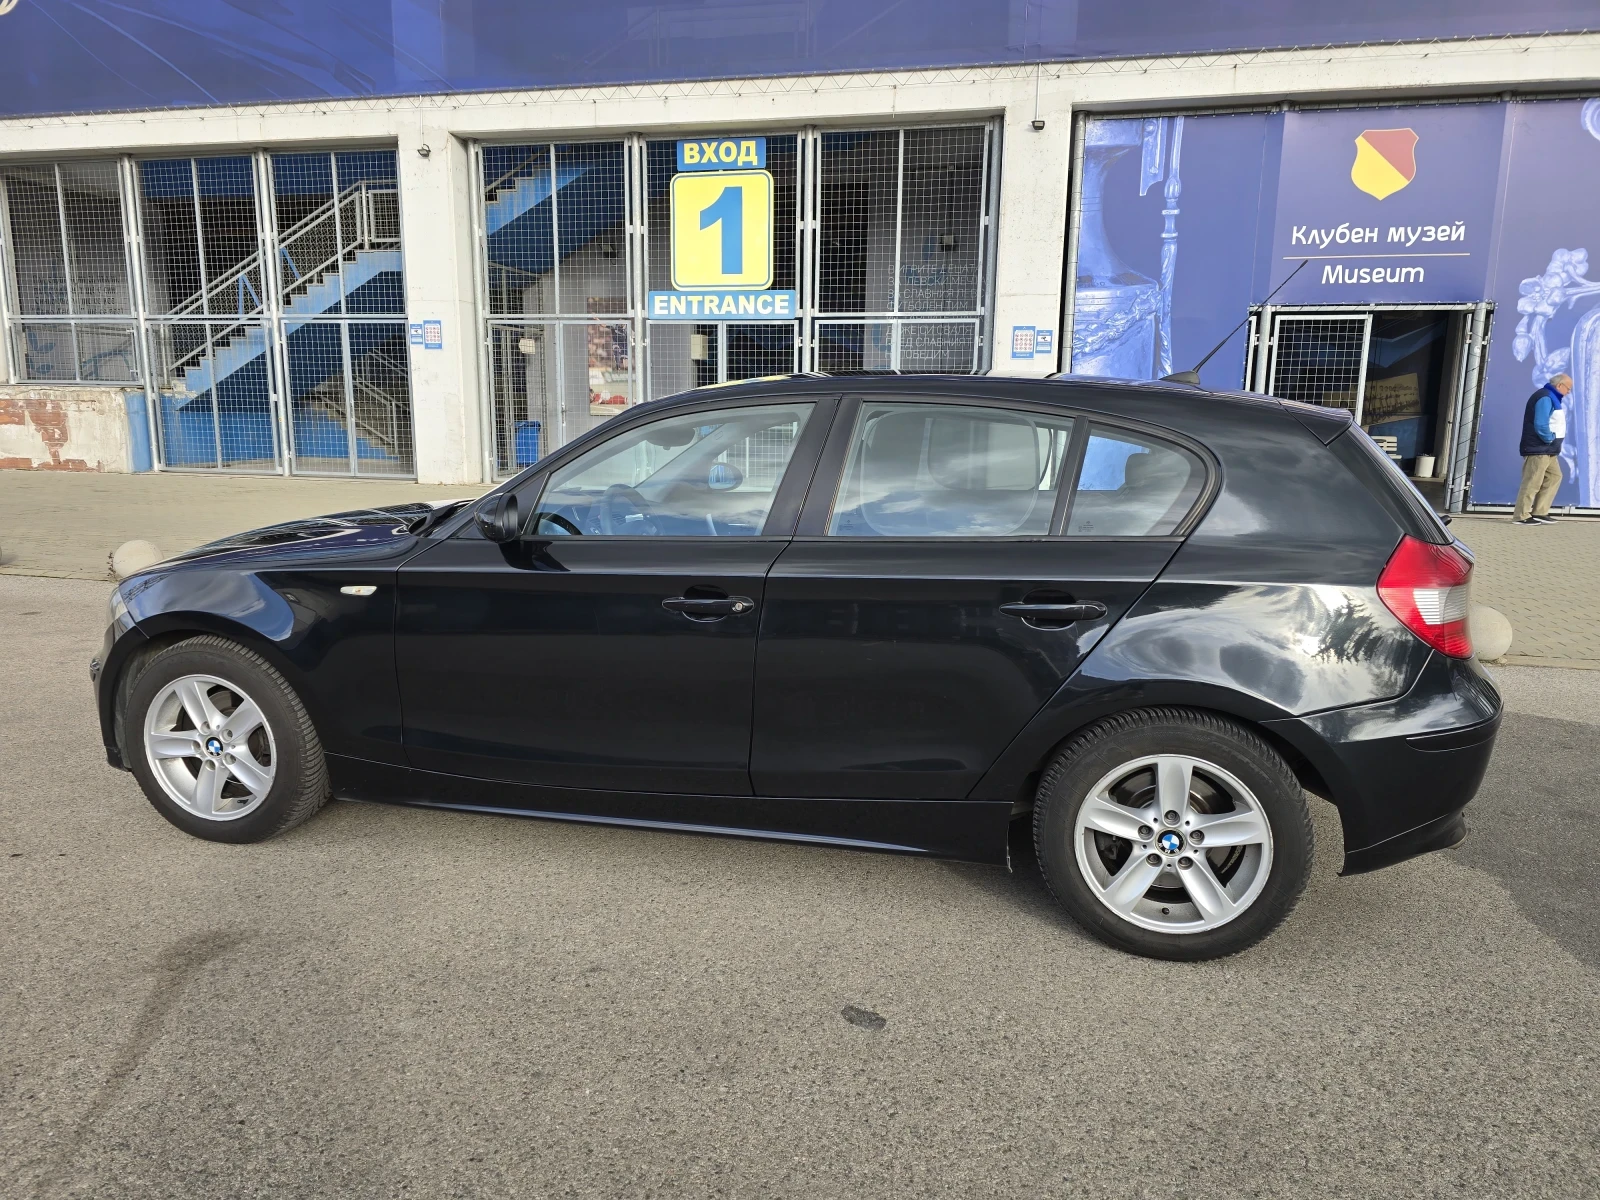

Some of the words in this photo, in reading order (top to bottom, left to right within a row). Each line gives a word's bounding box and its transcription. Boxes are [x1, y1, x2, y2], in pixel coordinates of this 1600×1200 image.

[683, 140, 758, 166] ВХОД
[699, 186, 743, 275] 1
[1291, 222, 1379, 249] Клубен
[1387, 220, 1466, 247] музей
[1321, 264, 1425, 284] Museum
[653, 294, 790, 315] ENTRANCE
